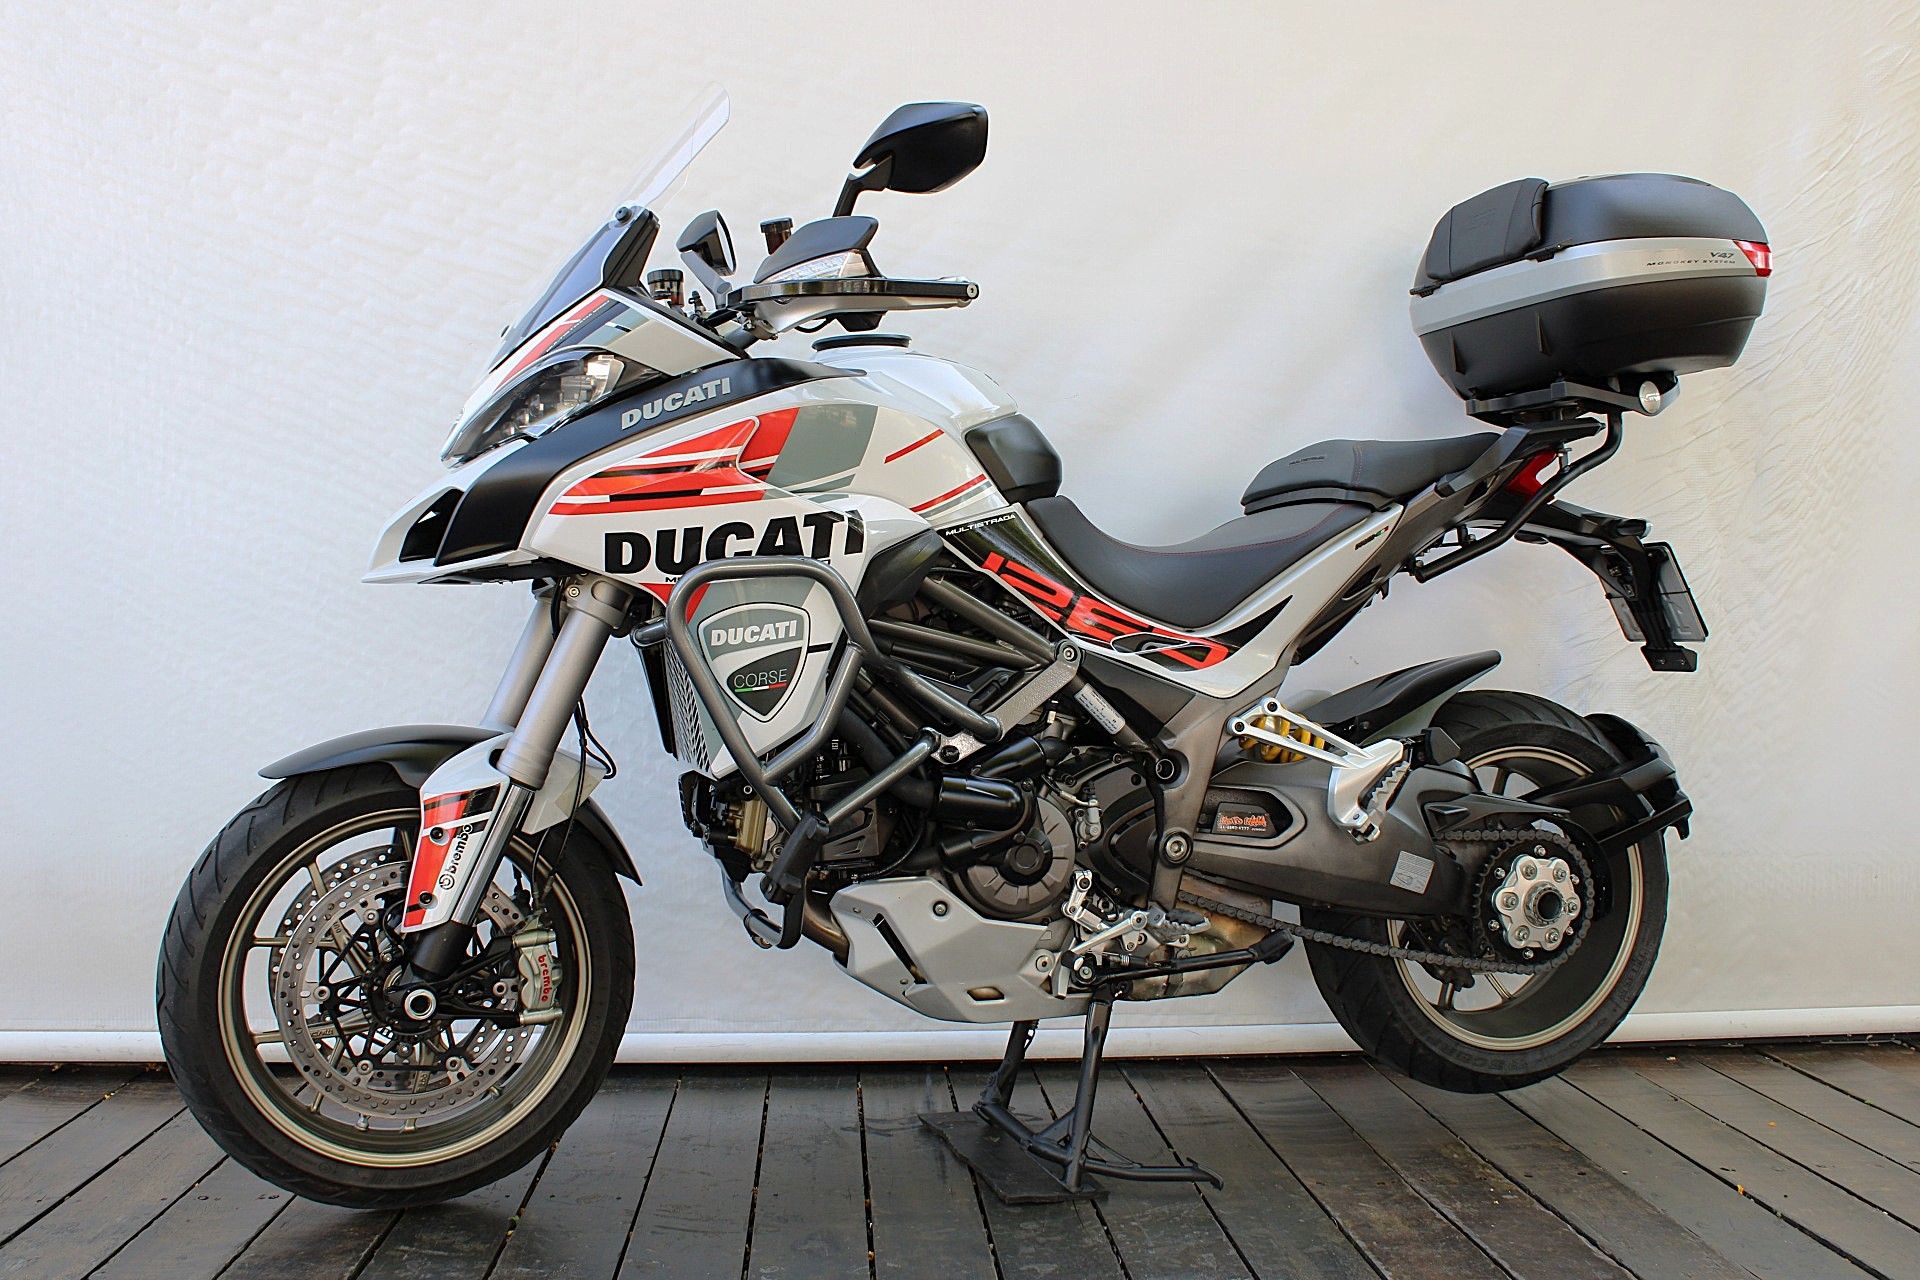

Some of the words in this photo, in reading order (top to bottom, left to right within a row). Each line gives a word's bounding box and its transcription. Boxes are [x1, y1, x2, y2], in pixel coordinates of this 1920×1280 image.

[1710, 251, 1735, 259] V47
[621, 377, 731, 430] DUCATI
[604, 509, 864, 575] DUCATI
[945, 514, 1016, 536] MULTISTRADA
[711, 620, 797, 646] DUCATI
[733, 668, 788, 688] CORSE
[450, 823, 474, 875] brembo
[537, 953, 549, 1003] brembo
